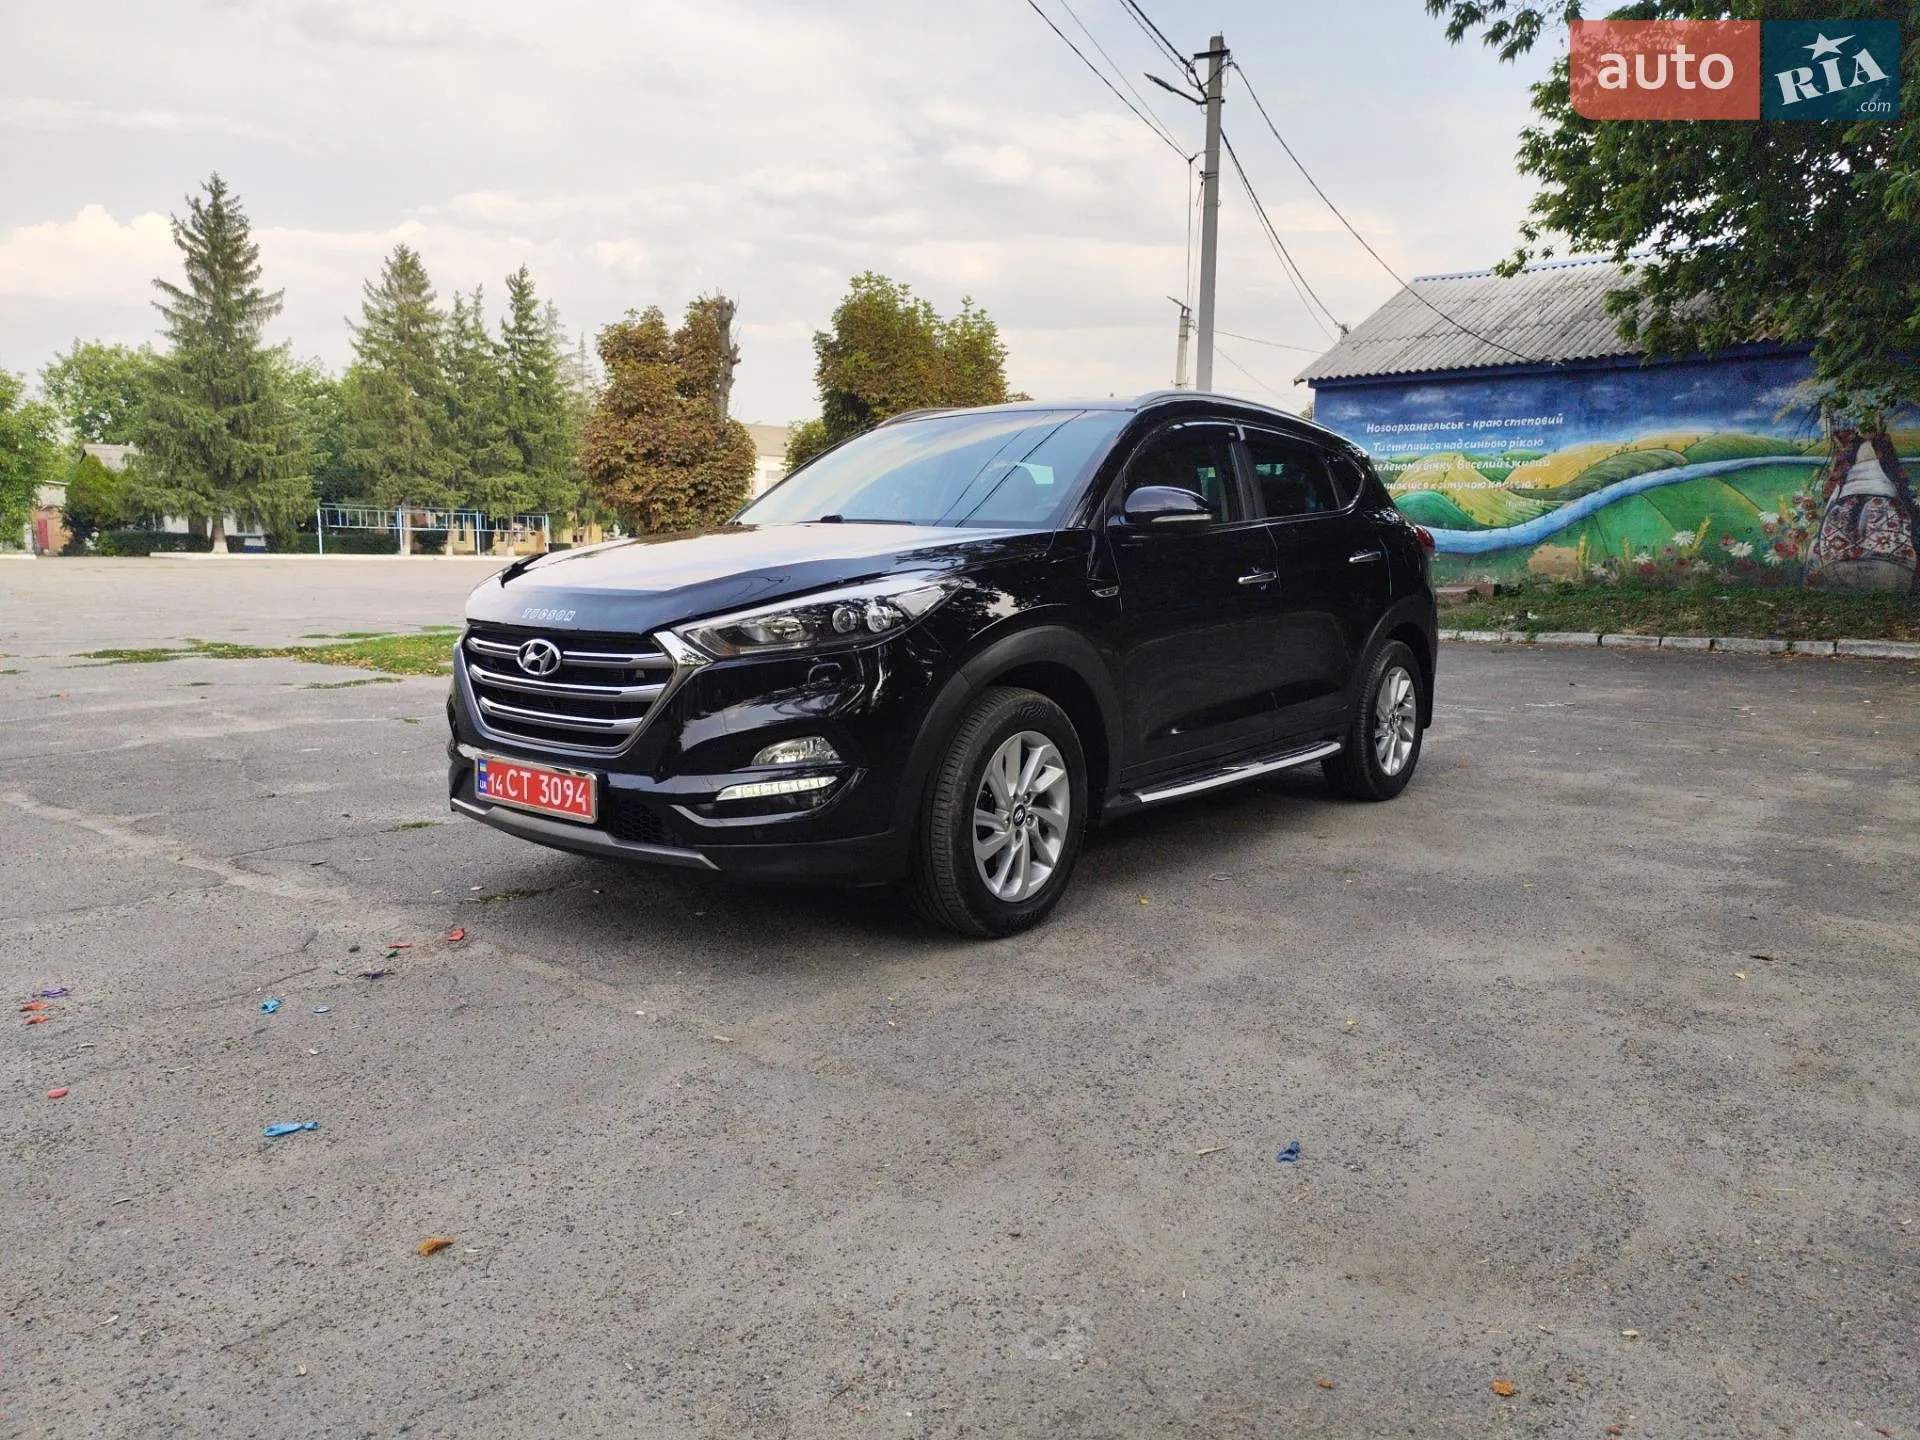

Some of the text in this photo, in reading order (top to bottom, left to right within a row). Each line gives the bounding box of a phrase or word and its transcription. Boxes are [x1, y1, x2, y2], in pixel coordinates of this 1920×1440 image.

[1473, 419, 1502, 430] краю
[1504, 413, 1563, 426] степовий
[1508, 437, 1544, 450] рікою
[539, 774, 587, 811] 3094
